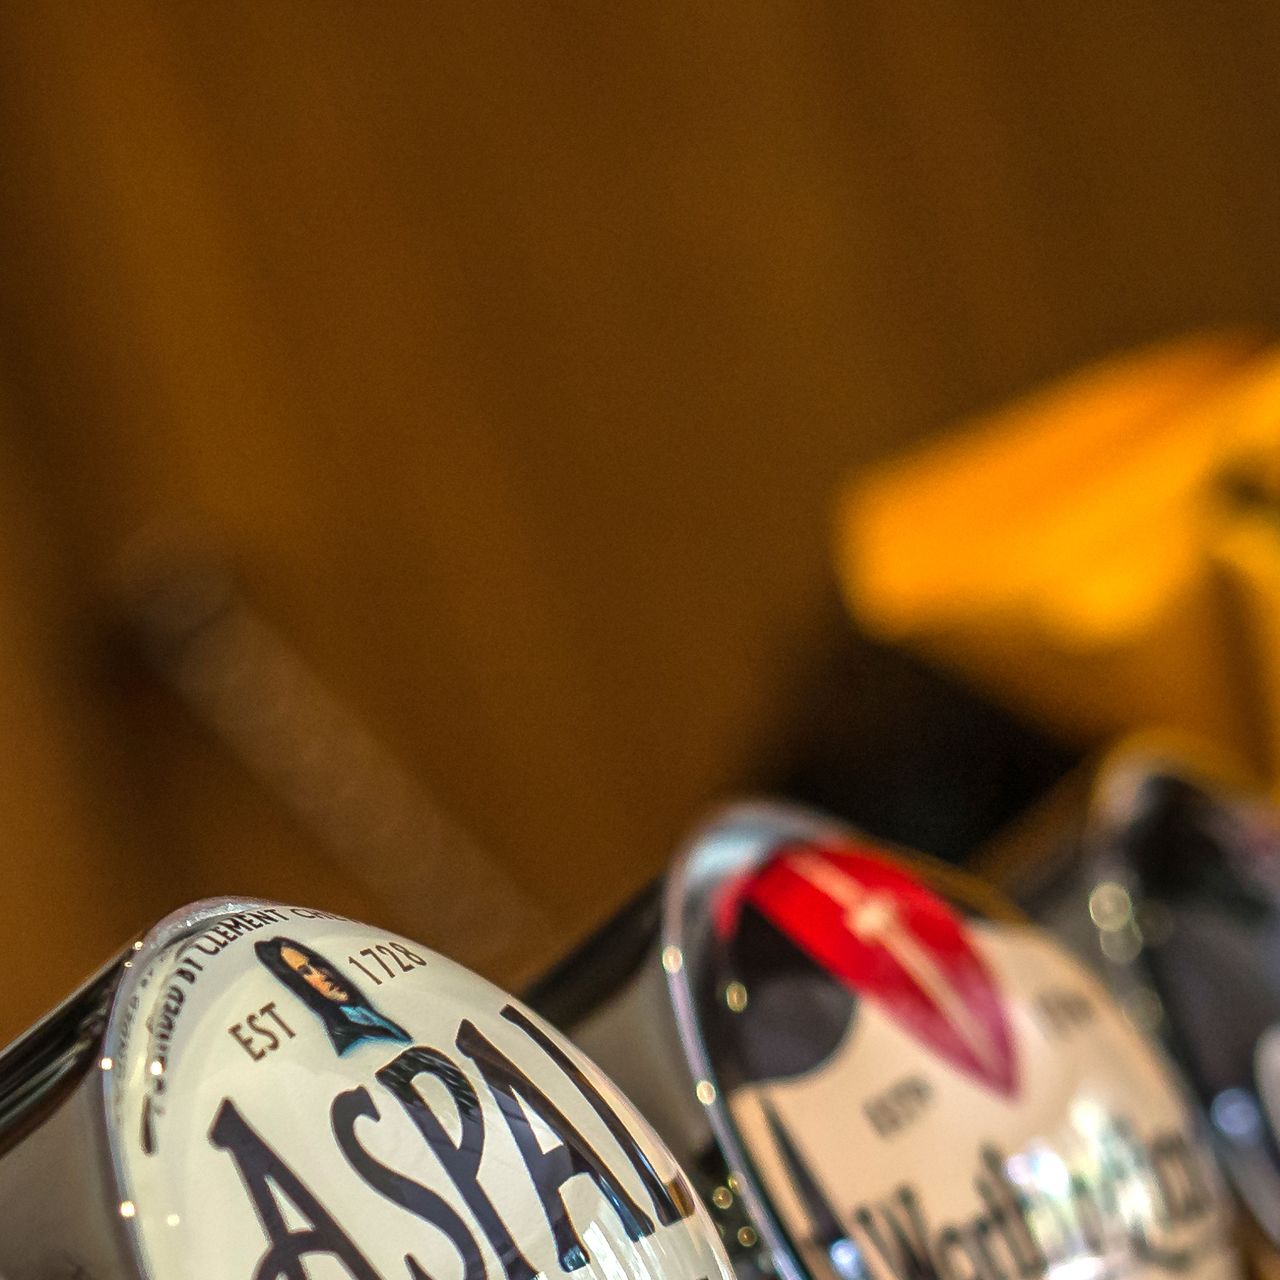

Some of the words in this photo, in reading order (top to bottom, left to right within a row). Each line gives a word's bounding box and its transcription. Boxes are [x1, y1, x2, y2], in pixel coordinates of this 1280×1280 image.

[195, 908, 290, 956] CLEMENT
[227, 1001, 297, 1063] EST
[348, 941, 427, 985] 1728
